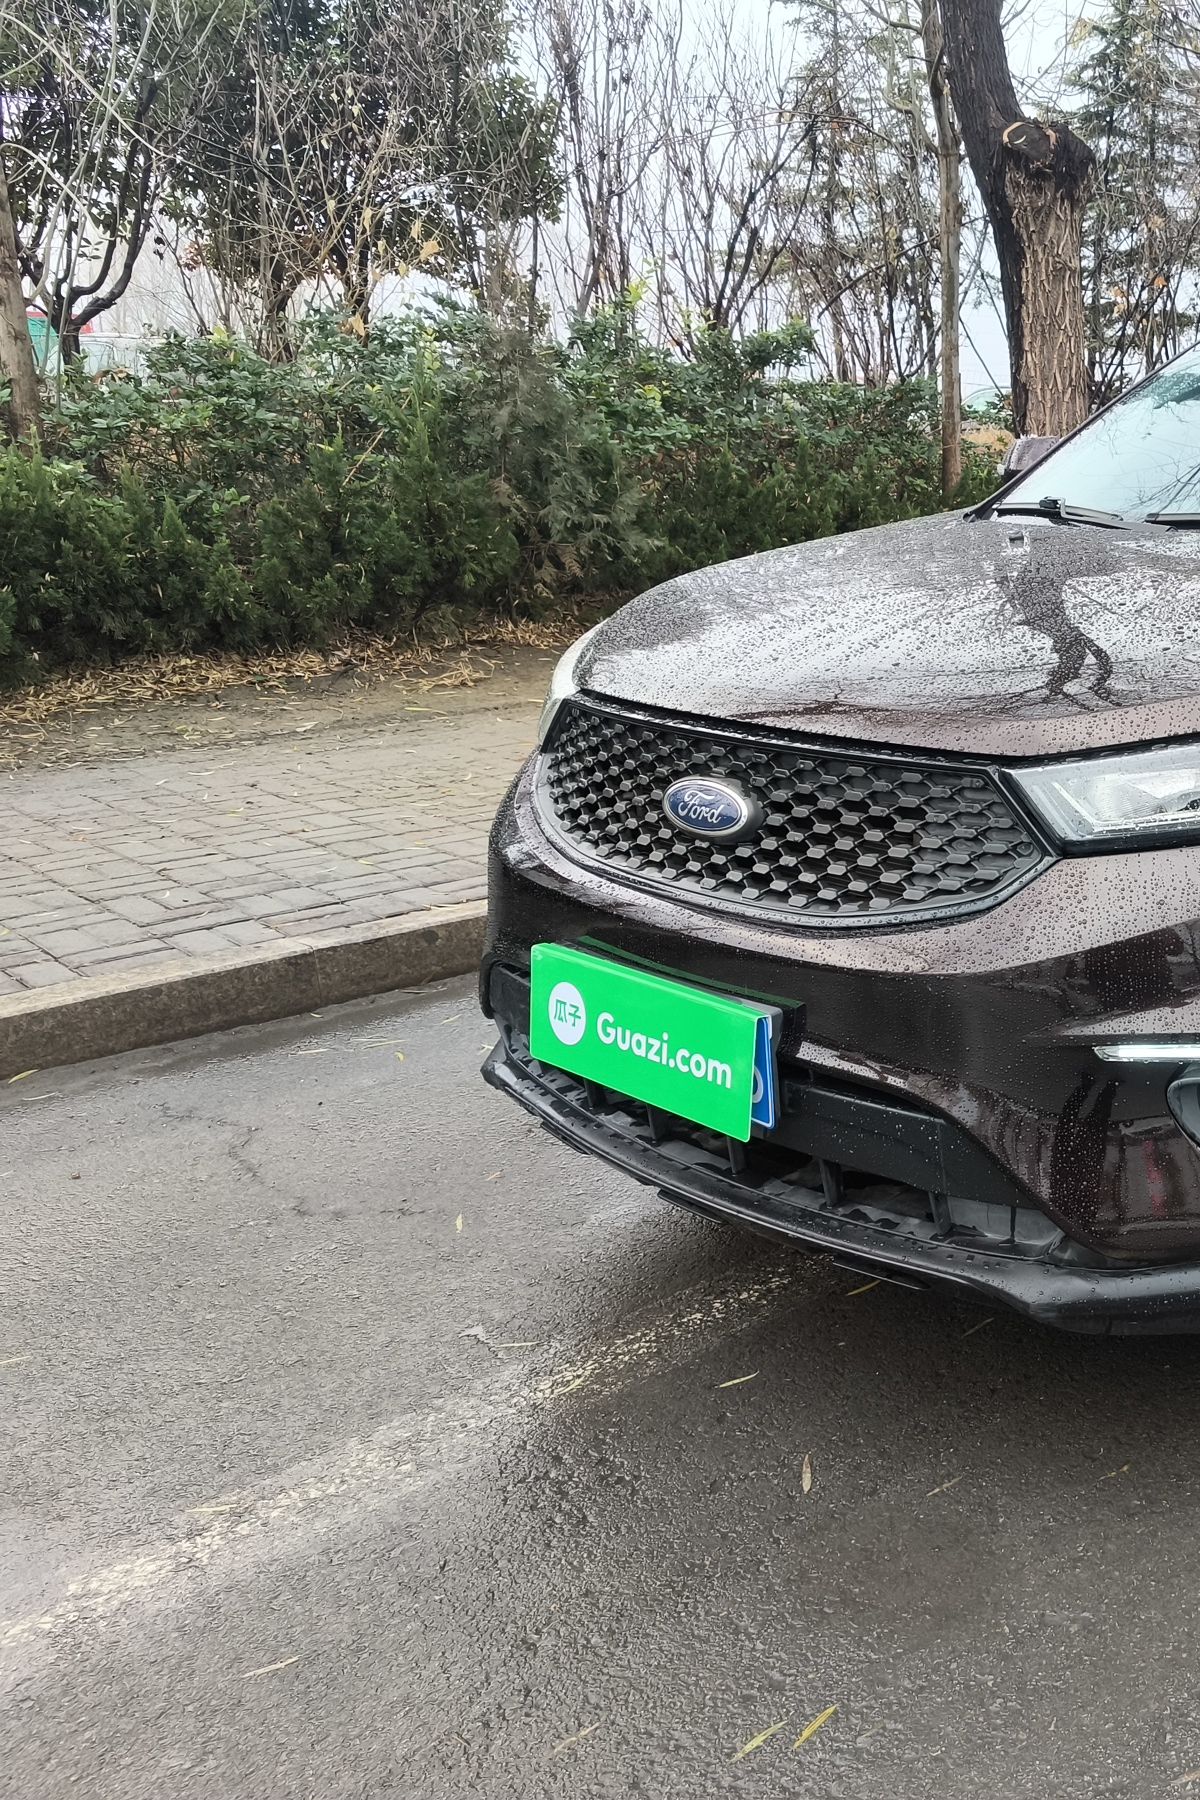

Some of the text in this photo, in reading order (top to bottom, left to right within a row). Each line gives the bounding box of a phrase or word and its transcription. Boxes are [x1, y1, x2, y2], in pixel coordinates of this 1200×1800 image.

[678, 790, 722, 823] Ford
[553, 998, 581, 1027] 瓜子
[596, 1012, 732, 1088] Guazi.com
